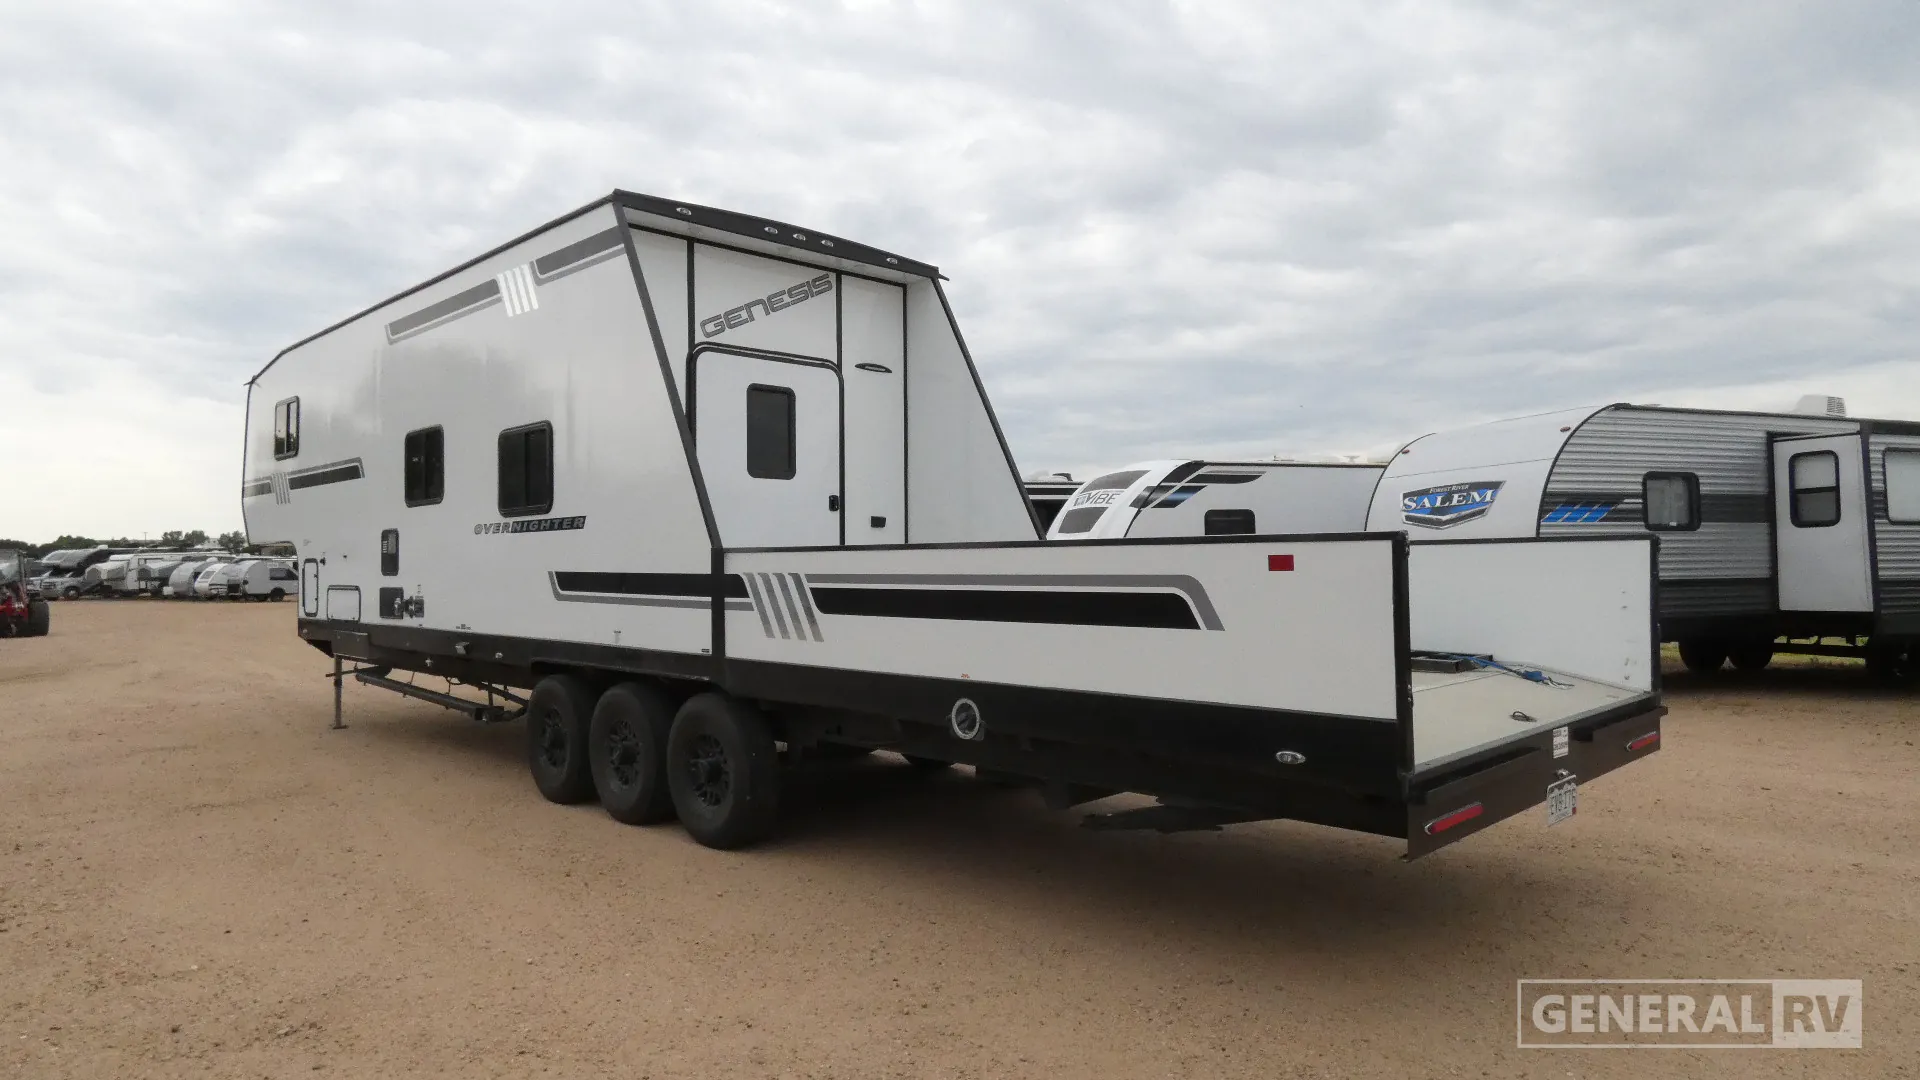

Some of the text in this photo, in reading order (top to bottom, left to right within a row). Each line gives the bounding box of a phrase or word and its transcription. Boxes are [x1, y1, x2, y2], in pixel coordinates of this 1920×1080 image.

[700, 273, 833, 338] GENESIS
[1402, 489, 1496, 510] SALEM
[474, 516, 585, 535] OVERNIGHTER
